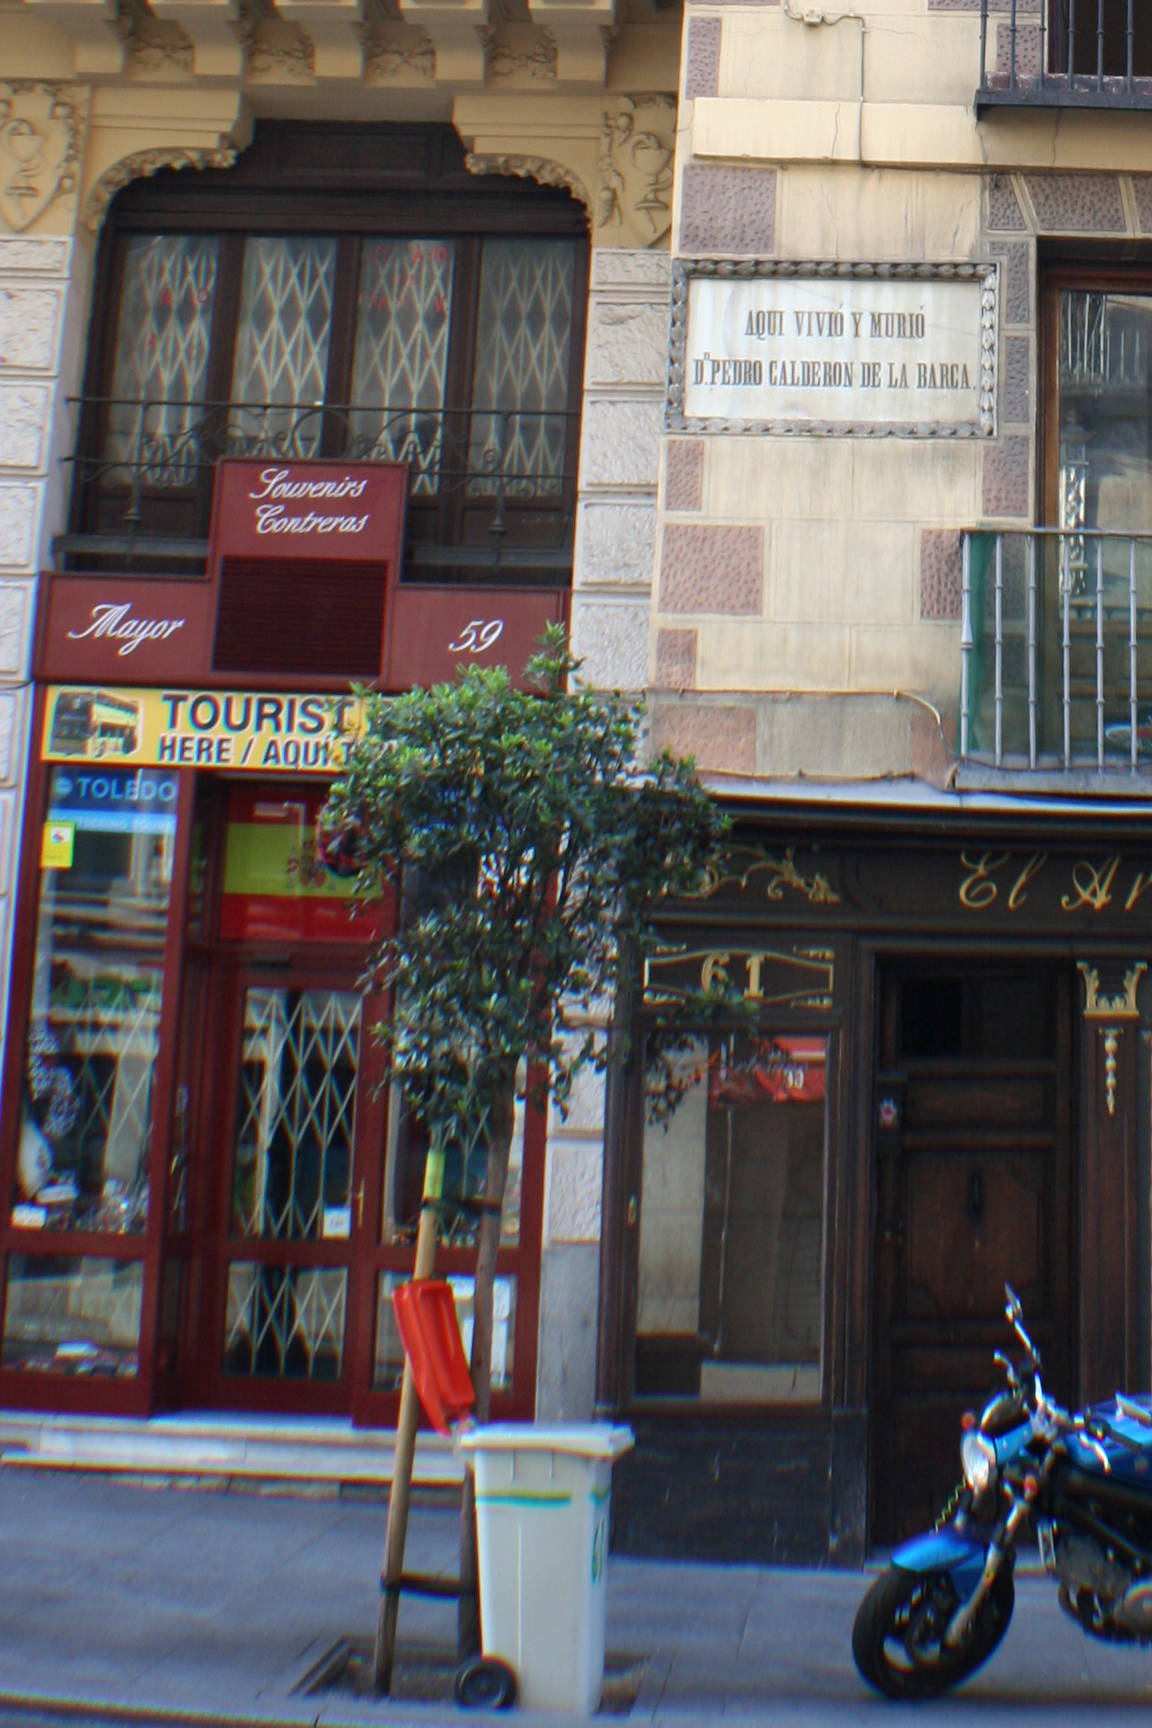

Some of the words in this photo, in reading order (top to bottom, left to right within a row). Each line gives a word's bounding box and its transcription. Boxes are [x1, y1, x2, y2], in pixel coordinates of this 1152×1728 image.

[744, 309, 785, 341] AQUI
[794, 303, 844, 338] VIVIÓ
[851, 311, 862, 338] Y
[870, 305, 926, 339] MURIÓ
[769, 359, 854, 388] CALDERON
[860, 362, 882, 388] DE
[888, 362, 909, 389] LA
[248, 467, 368, 499] Souvenirs
[255, 503, 370, 534] Contreras
[66, 601, 185, 656] Mayor
[447, 618, 505, 654] 59
[162, 694, 355, 733] TOURIST
[159, 735, 232, 763] HERE
[76, 776, 178, 803] TOLEDO
[959, 851, 1049, 910] El
[701, 952, 765, 1001] 61
